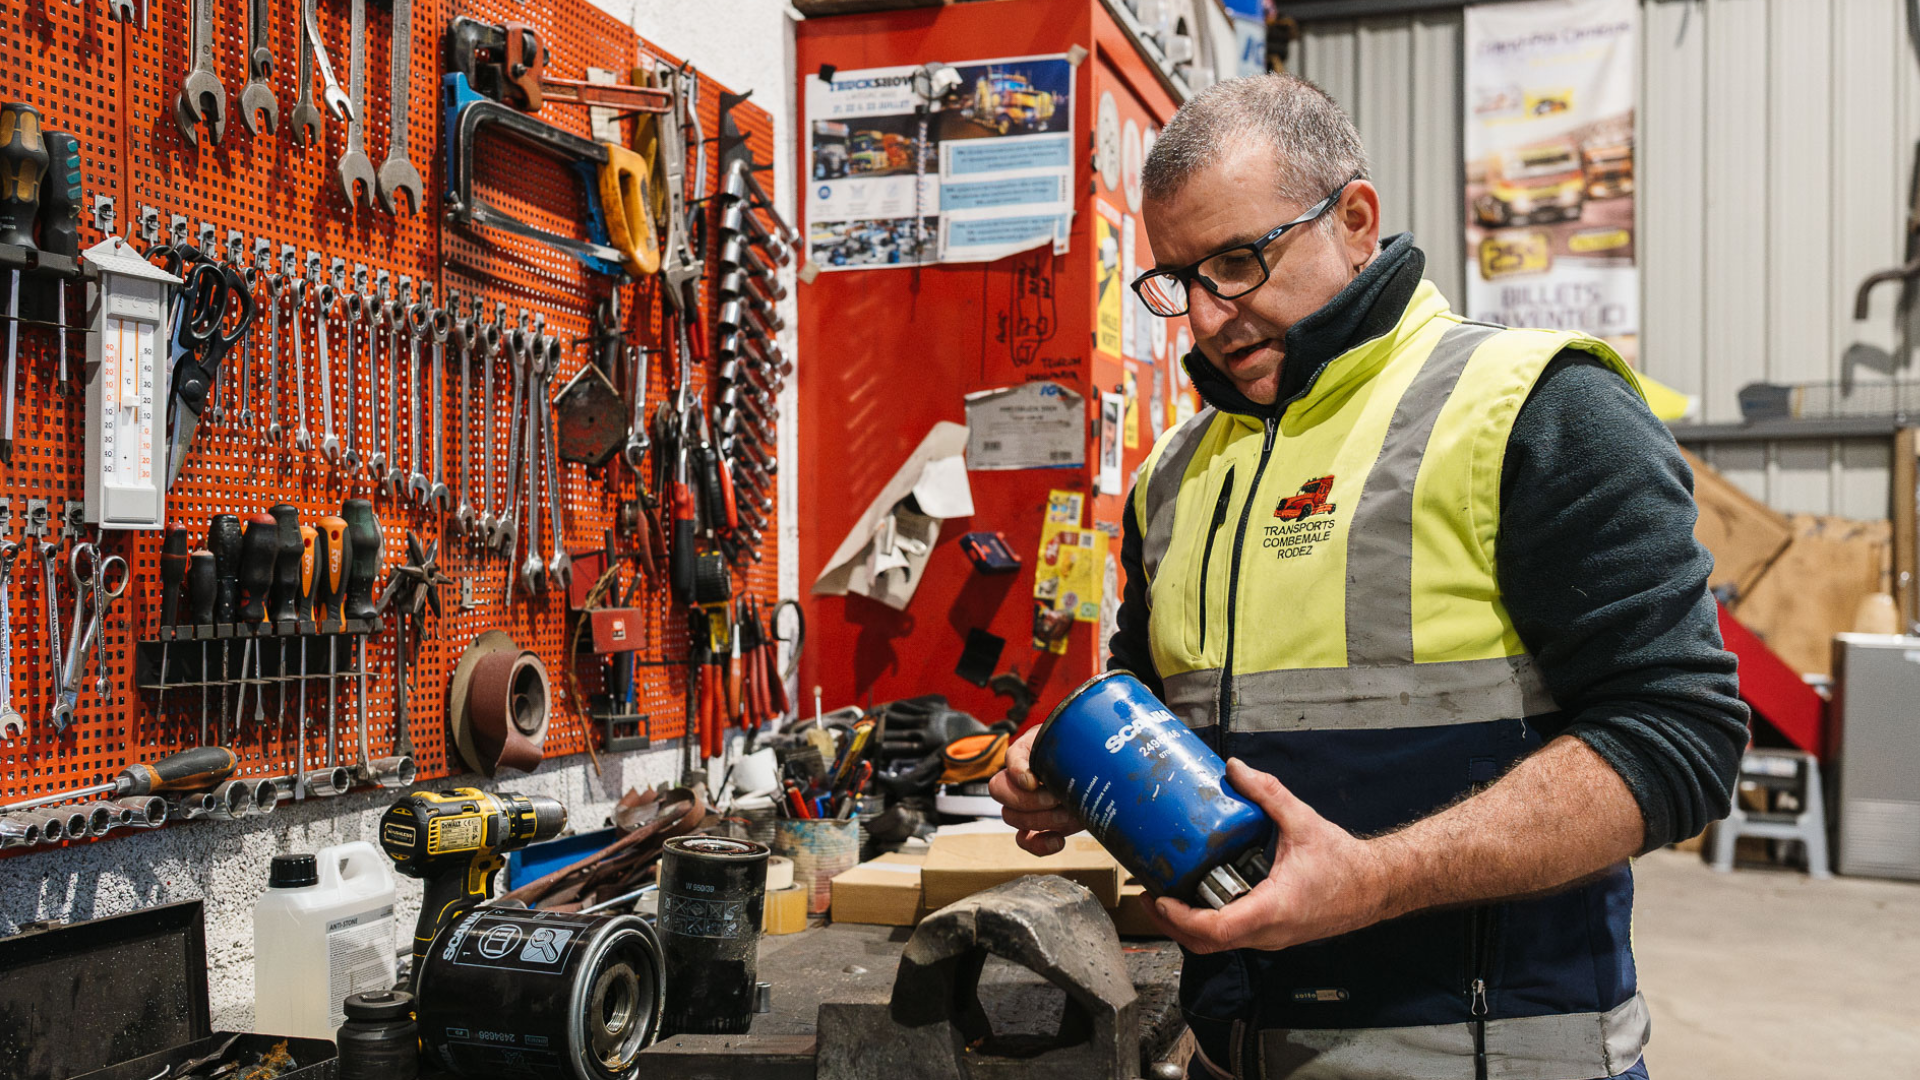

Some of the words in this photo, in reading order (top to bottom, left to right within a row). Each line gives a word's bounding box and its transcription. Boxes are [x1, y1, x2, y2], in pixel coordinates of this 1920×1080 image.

[1264, 520, 1335, 537] TRANSPORTS
[1262, 531, 1331, 548] COMBEMALE
[1277, 545, 1313, 559] RODEZ
[331, 549, 339, 573] CLAS
[1104, 709, 1177, 754] SCANIA
[685, 882, 692, 890] W
[693, 883, 715, 893] 950/39
[329, 917, 359, 931] ANTI-STONE
[442, 910, 487, 961] SCANIA
